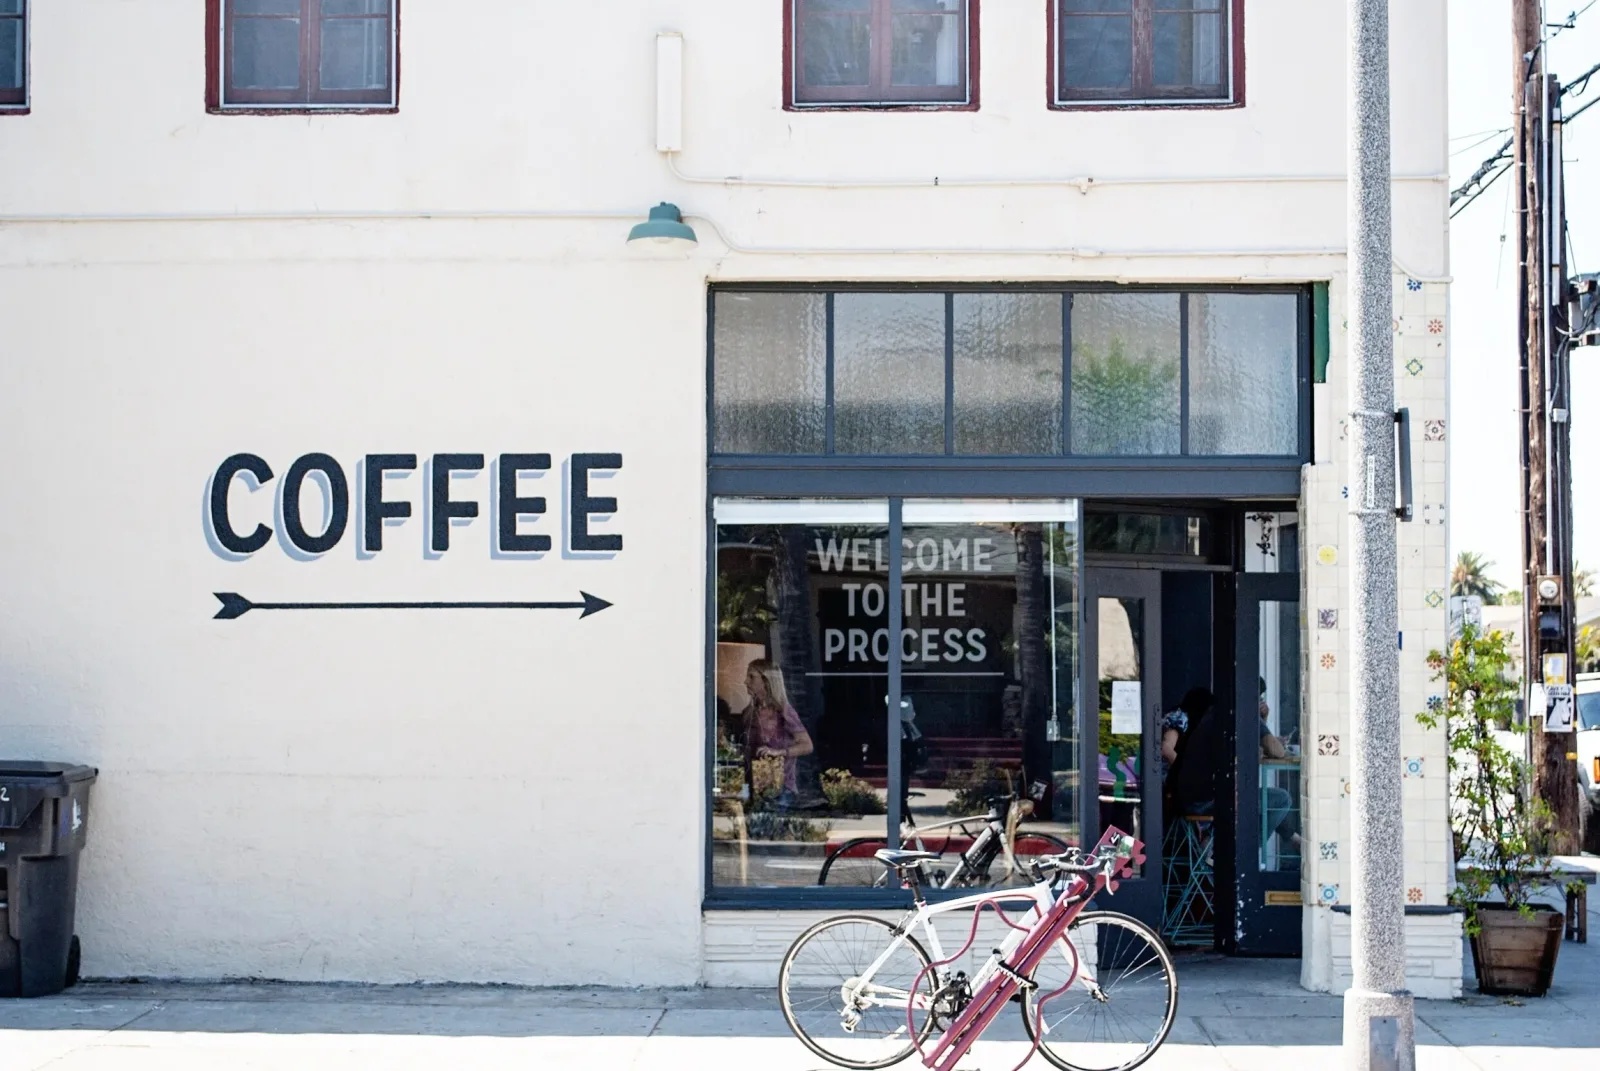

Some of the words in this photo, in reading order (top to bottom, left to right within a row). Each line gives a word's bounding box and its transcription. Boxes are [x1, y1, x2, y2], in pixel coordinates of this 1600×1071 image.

[202, 452, 623, 562] COFFEE
[815, 537, 992, 572] WELCOME
[842, 582, 885, 617] TO
[901, 583, 966, 617] THE
[825, 627, 987, 662] PROCESS
